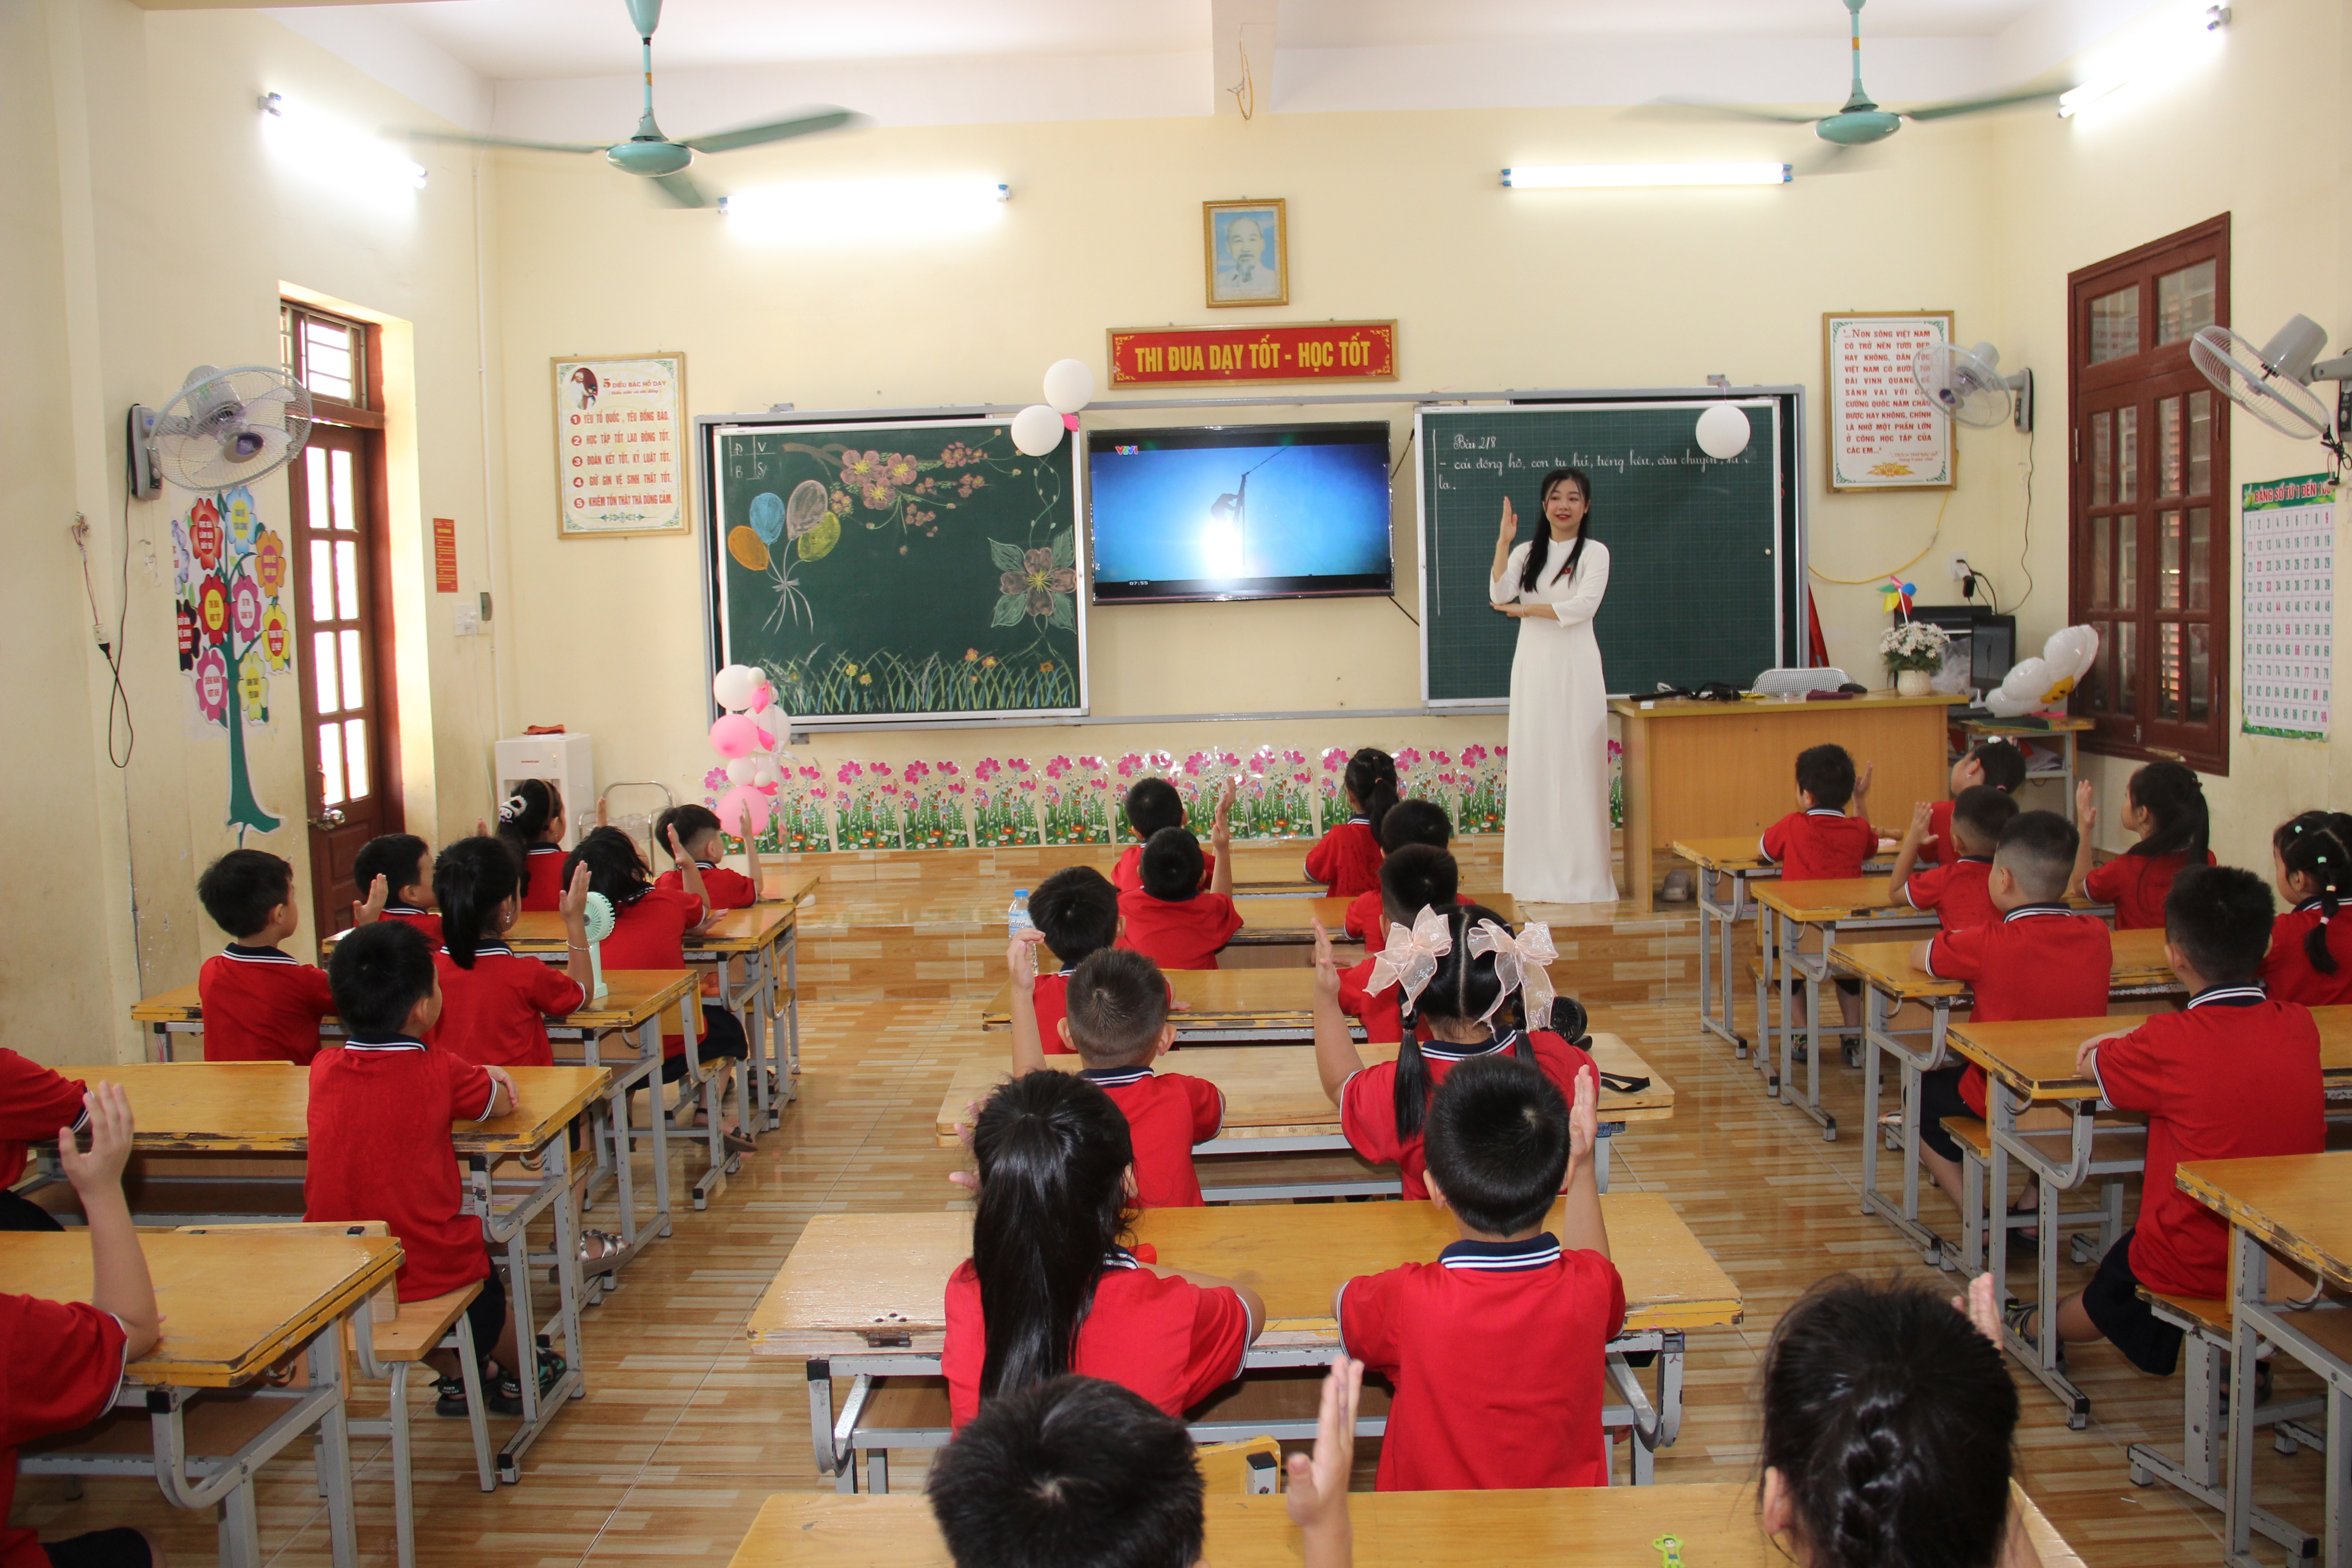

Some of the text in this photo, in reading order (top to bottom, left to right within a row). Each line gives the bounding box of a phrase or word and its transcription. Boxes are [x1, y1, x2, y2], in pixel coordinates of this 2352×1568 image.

[1896, 330, 1911, 338] VIỆT
[1859, 340, 1872, 349] TRỞ
[1135, 348, 1162, 372] THI
[1168, 345, 1204, 371] ĐUA
[1210, 344, 1244, 375] DẠY
[1249, 334, 1280, 368] TỐT
[1298, 341, 1333, 372] HỌC
[1339, 332, 1371, 367] TỐT
[1845, 365, 1859, 374] VIỆT
[603, 378, 611, 388] 5
[584, 413, 593, 424] YÊU
[597, 410, 603, 423] TỔ
[606, 410, 619, 424] QUỐC
[627, 411, 637, 422] YÊU
[640, 409, 654, 421] ĐỒNG
[657, 410, 669, 421] BÀO.
[587, 435, 597, 446] HỌC
[601, 433, 610, 446] TẬP
[614, 431, 623, 443] TỐT
[627, 433, 637, 443] LAO
[641, 431, 655, 444] ĐỘNG
[659, 429, 670, 441] TỐT.
[1454, 435, 1475, 450] Bài
[1847, 434, 1851, 442] Ở
[1899, 434, 1911, 443] TẬP
[1918, 432, 1931, 441] CỦA
[757, 442, 767, 452] V
[1115, 446, 1138, 455] VTV1
[588, 455, 602, 465] ĐOÀN
[606, 451, 615, 464] KẾT
[619, 451, 629, 465] TỐT,
[633, 450, 640, 463] KỶ
[644, 451, 656, 465] LUẬT
[660, 450, 671, 463] TỐT.
[735, 466, 743, 478] B
[1455, 458, 1472, 470] cái
[1476, 457, 1503, 476] đồng
[1531, 459, 1549, 468] con
[1555, 457, 1566, 467] tu
[590, 474, 598, 486] GIỮ
[603, 474, 612, 485] GÌN
[616, 474, 622, 487] VỆ
[627, 475, 640, 485] SINH
[644, 472, 656, 486] THẬT
[661, 470, 672, 483] TỐT.
[589, 495, 605, 506] KHIÊM
[607, 493, 617, 506] TỐN
[618, 494, 631, 507] THẬT
[632, 493, 642, 505] THÀ
[643, 493, 657, 504] DŨNG
[659, 490, 672, 504] CẢM.
[2255, 486, 2274, 503] BẢNG
[2275, 482, 2284, 500] SỐ
[2286, 483, 2295, 499] TỪ
[2296, 485, 2299, 498] 1
[2302, 479, 2317, 497] ĐẾN
[2249, 536, 2309, 551] 11 12 13 14 15 17
